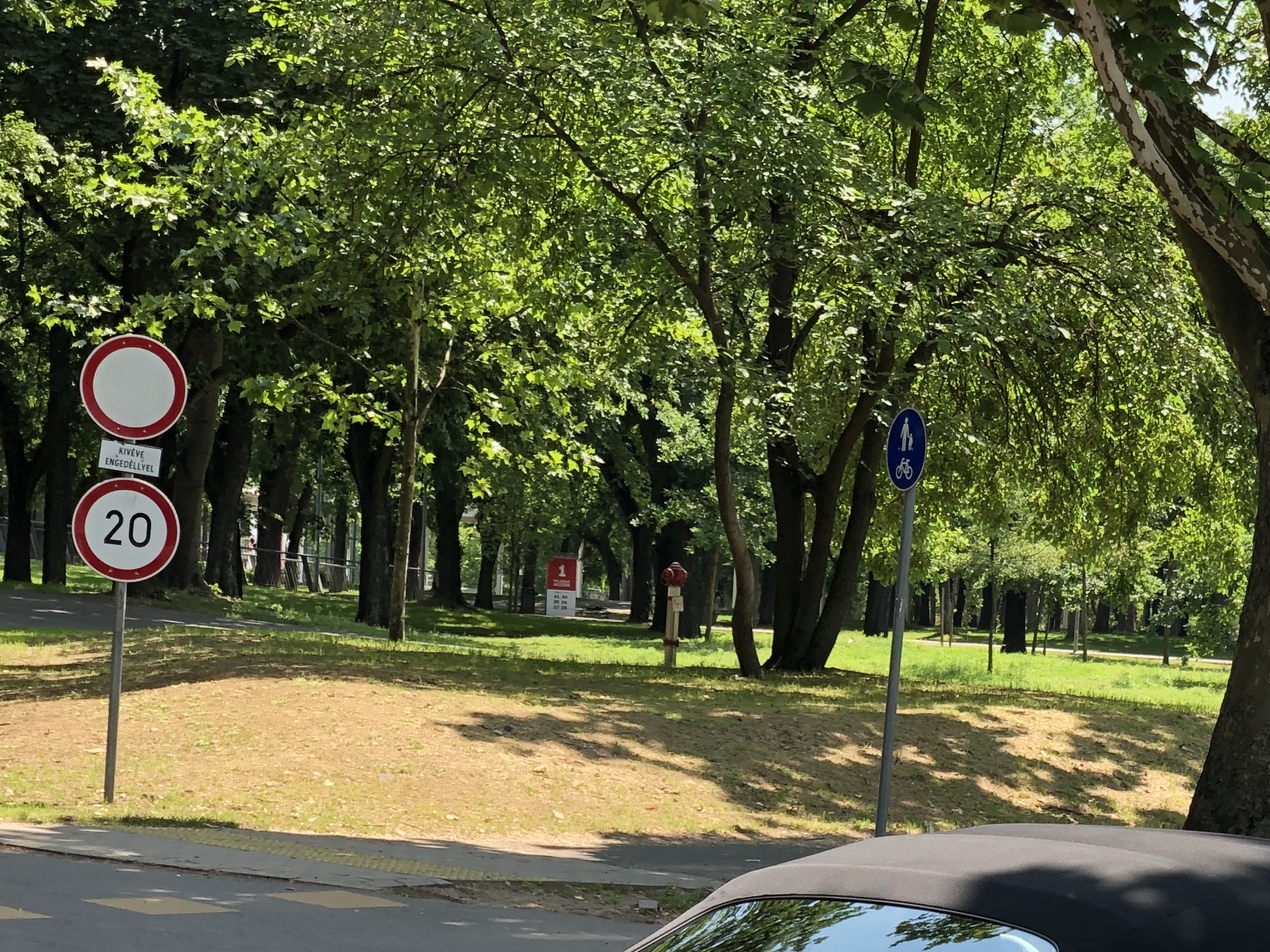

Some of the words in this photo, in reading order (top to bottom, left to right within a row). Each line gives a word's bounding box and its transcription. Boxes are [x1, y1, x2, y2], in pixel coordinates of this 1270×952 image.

[118, 446, 145, 459] KIVÉVE
[105, 457, 154, 473] ENGEDÉLLYEL
[103, 509, 152, 548] 20
[558, 564, 566, 578] 1
